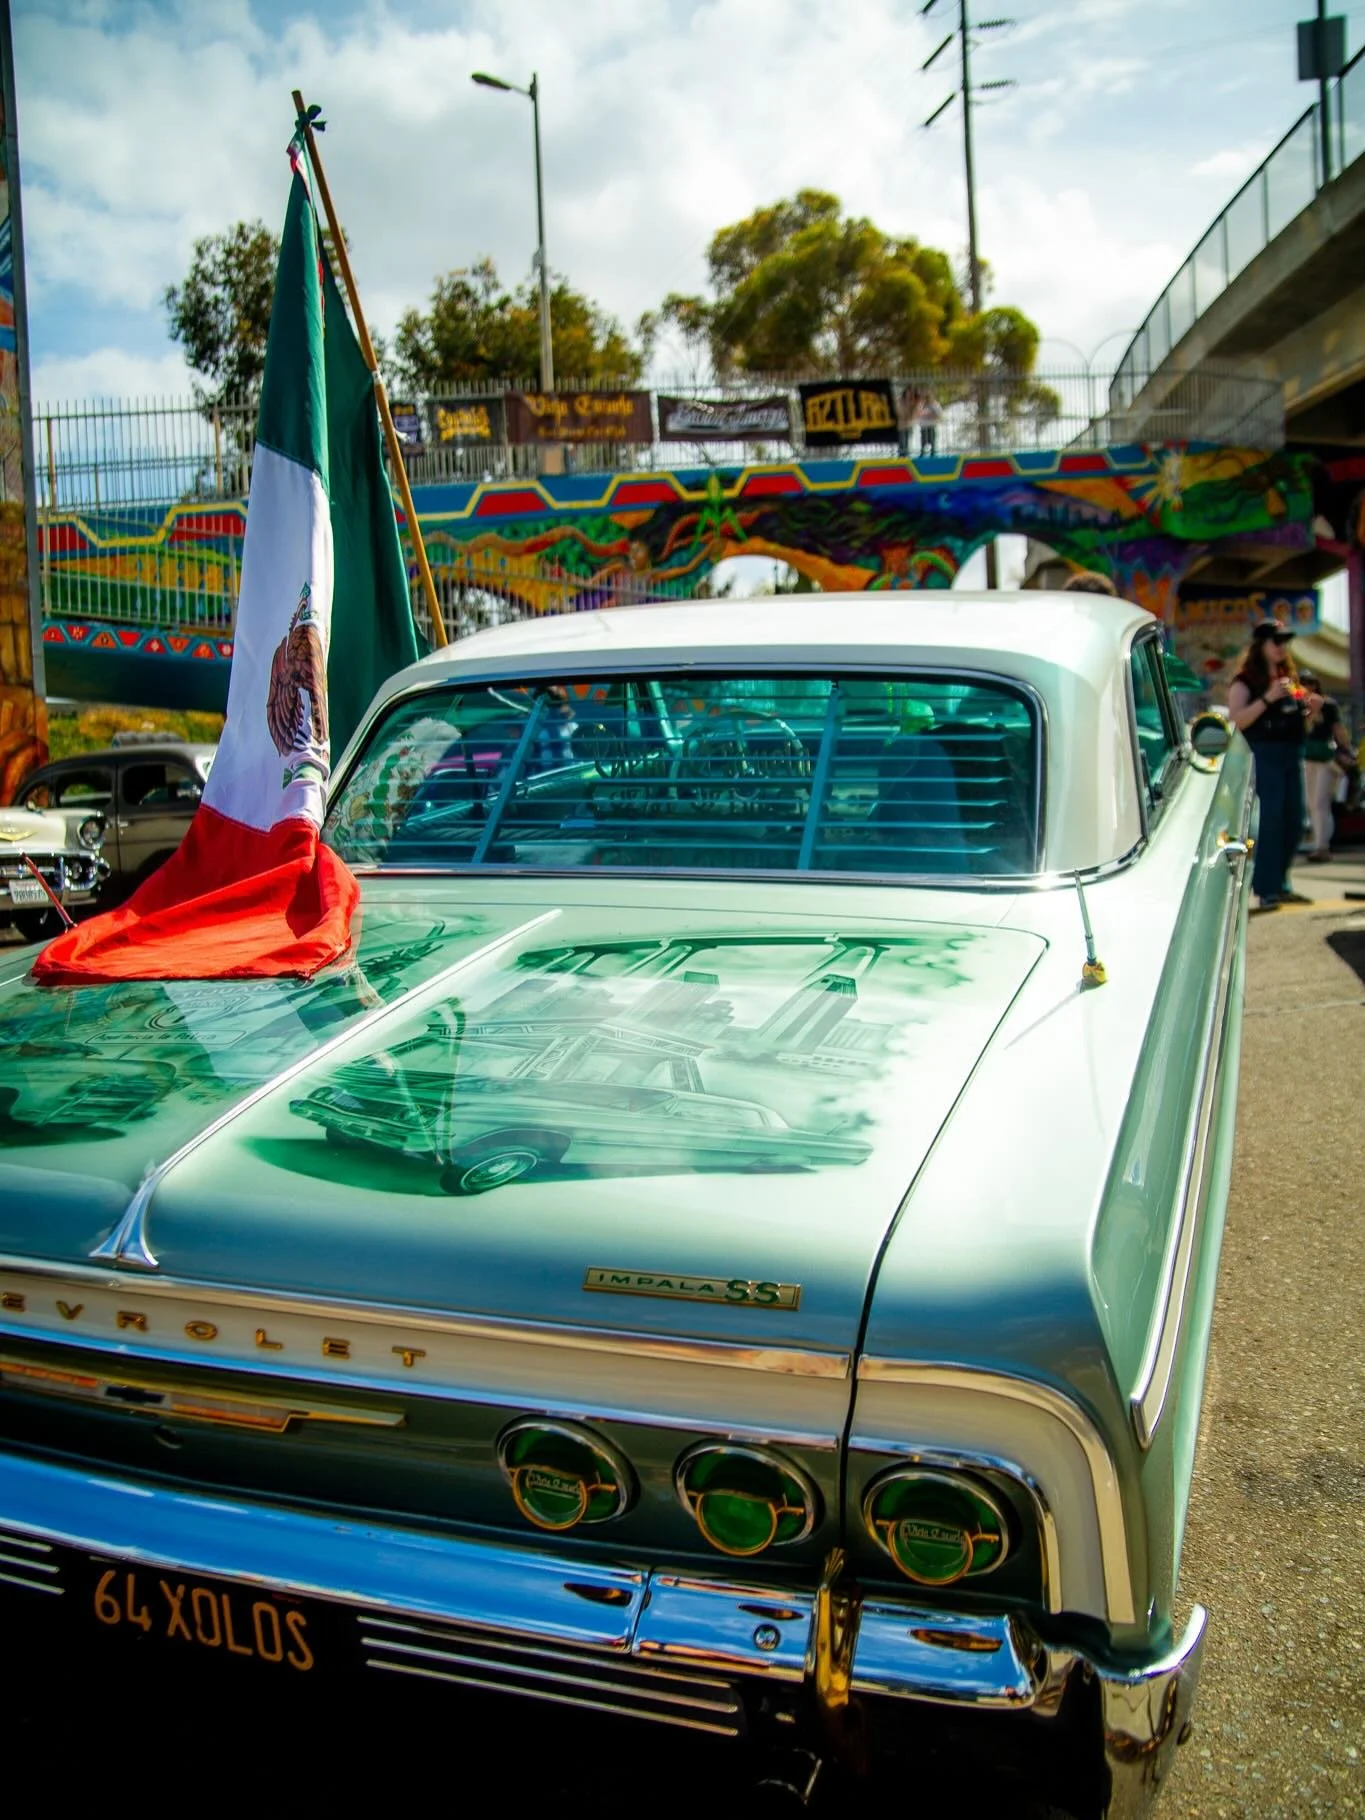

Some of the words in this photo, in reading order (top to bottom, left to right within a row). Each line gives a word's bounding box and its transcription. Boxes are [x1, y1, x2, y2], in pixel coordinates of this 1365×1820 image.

[597, 1273, 715, 1294] IMPALA
[724, 1279, 781, 1305] SS
[94, 1569, 152, 1632] 64
[159, 1579, 315, 1672] XOLOS
